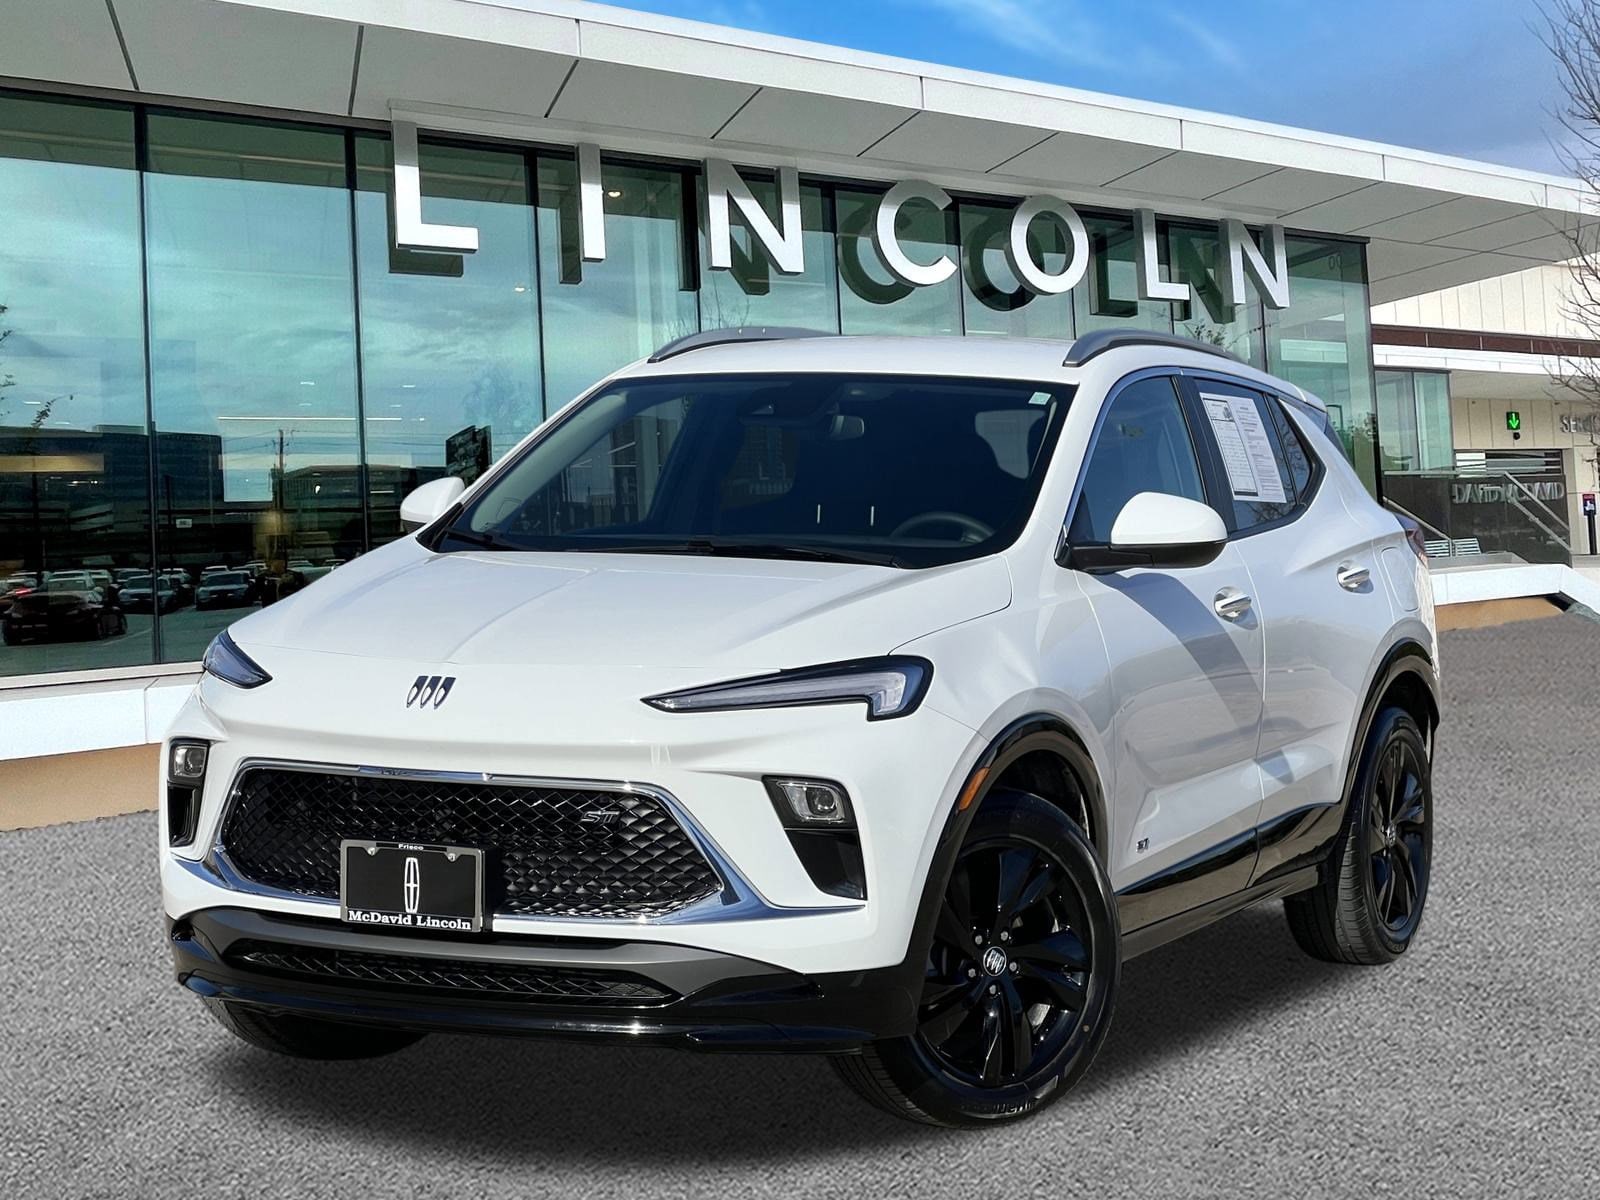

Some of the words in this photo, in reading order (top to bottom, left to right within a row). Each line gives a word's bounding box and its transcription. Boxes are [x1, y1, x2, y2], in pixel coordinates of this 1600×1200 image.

[390, 120, 1290, 310] LINCOLN
[398, 843, 424, 851] Frisco
[348, 910, 412, 926] McDavid
[416, 915, 472, 930] Lincoln
